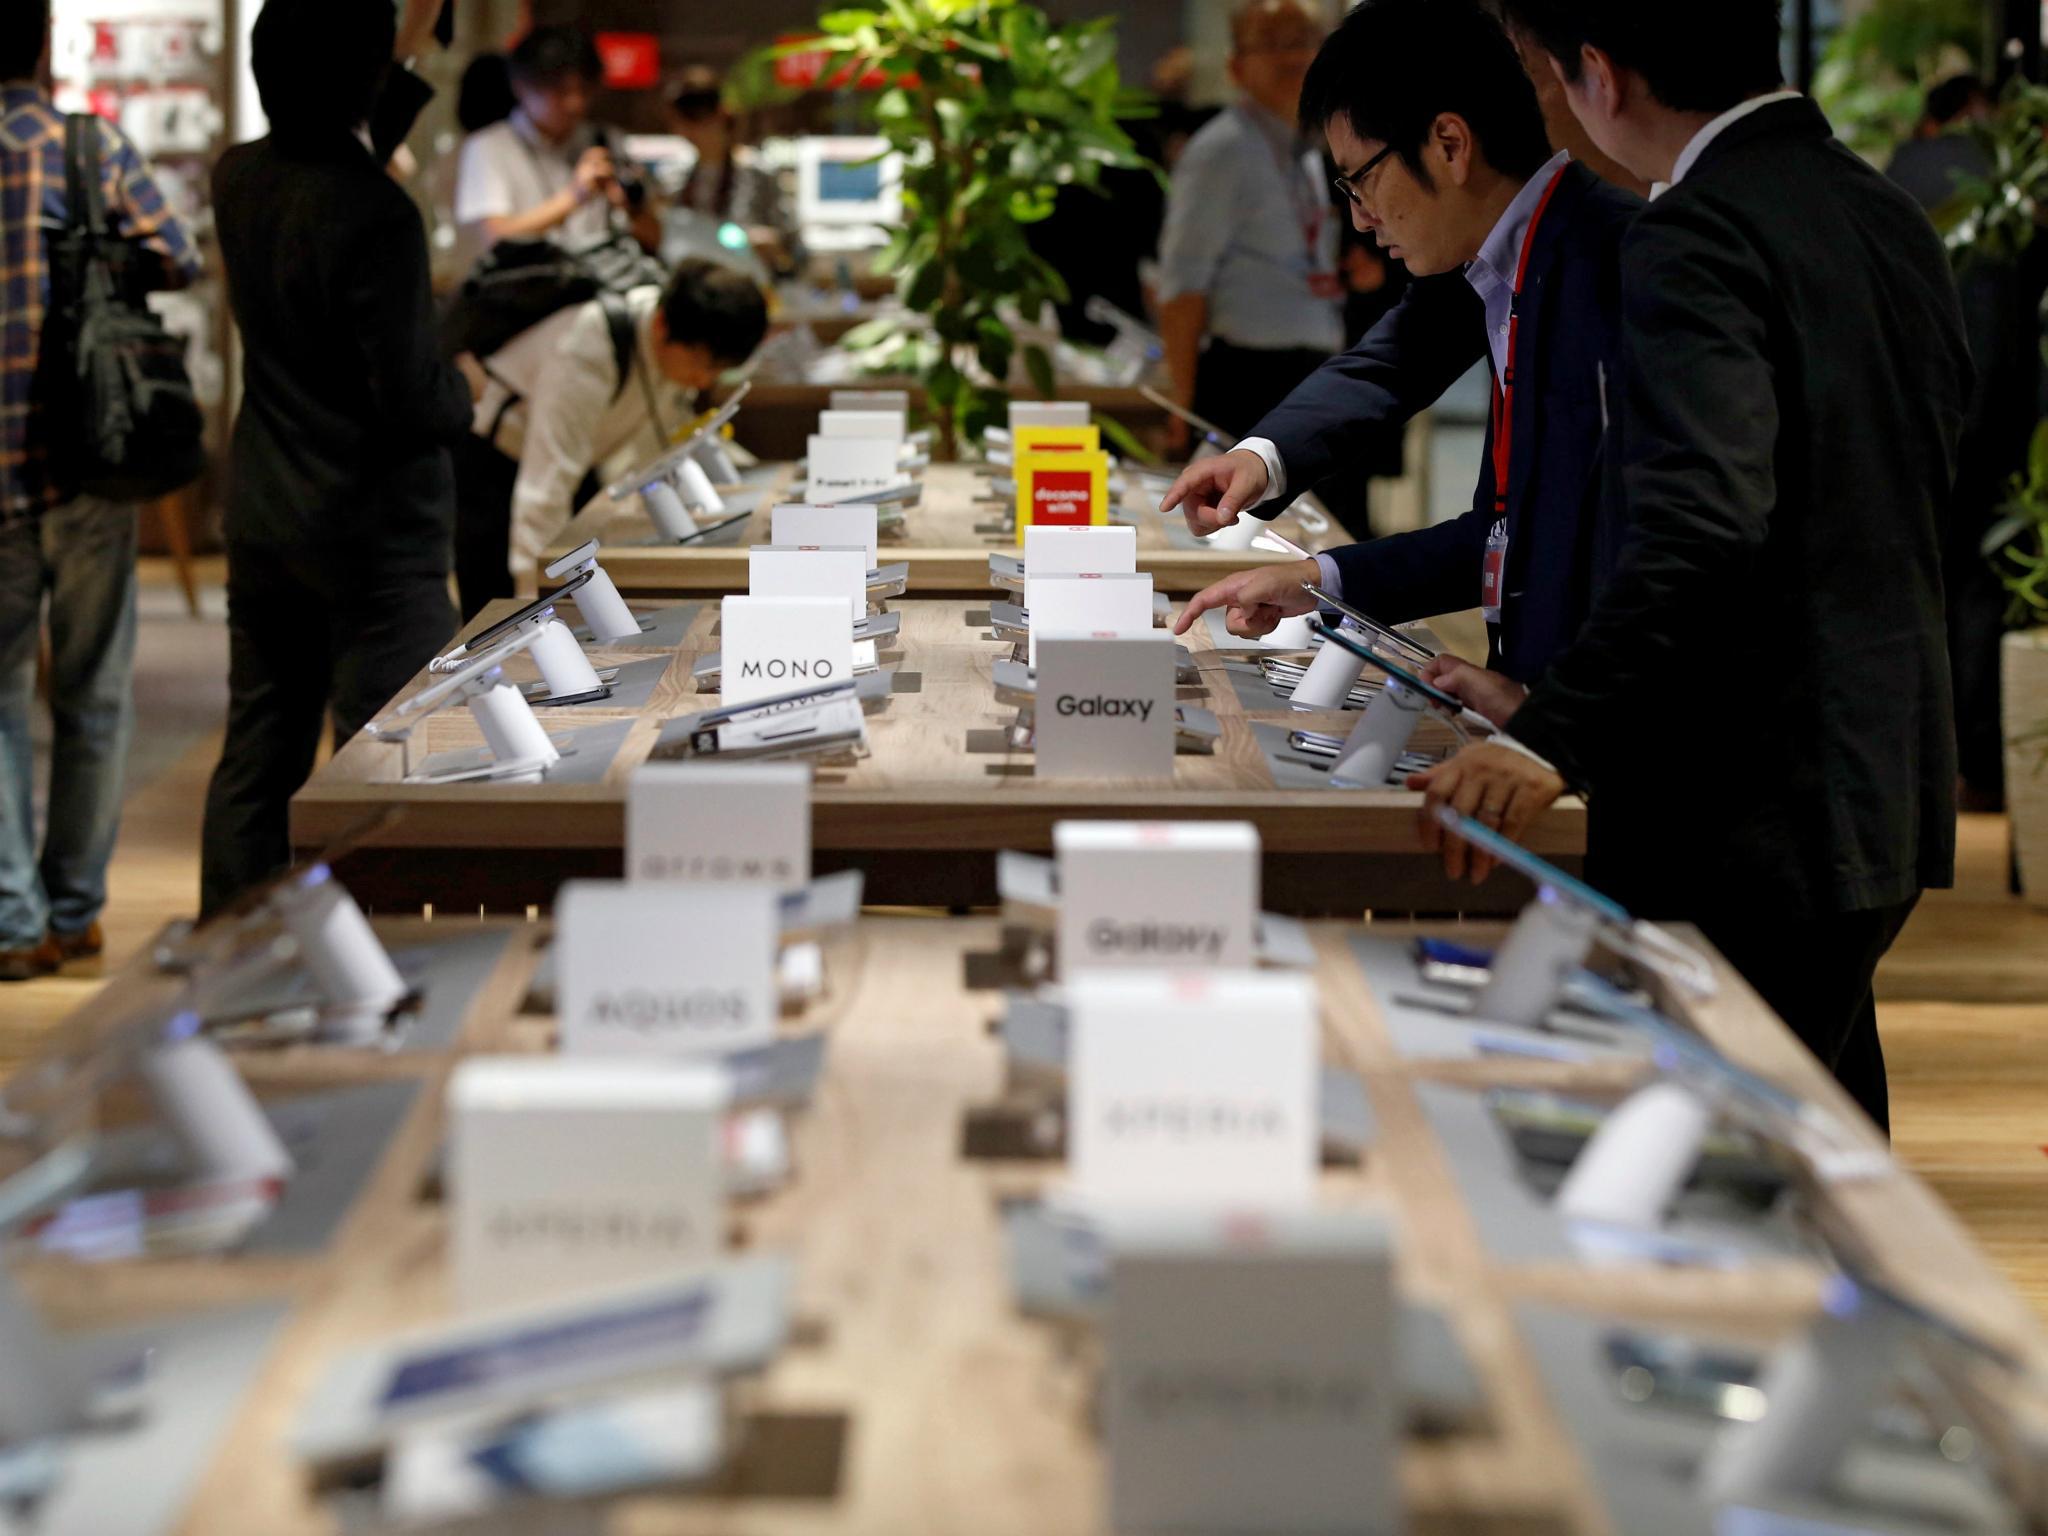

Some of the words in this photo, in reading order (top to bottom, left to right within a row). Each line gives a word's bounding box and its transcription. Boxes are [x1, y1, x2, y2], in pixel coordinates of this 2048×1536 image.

[1035, 488, 1089, 502] docomo
[1047, 502, 1077, 514] with
[741, 659, 833, 679] MONO
[1056, 694, 1154, 722] Galaxy
[1087, 918, 1229, 958] Galaxy
